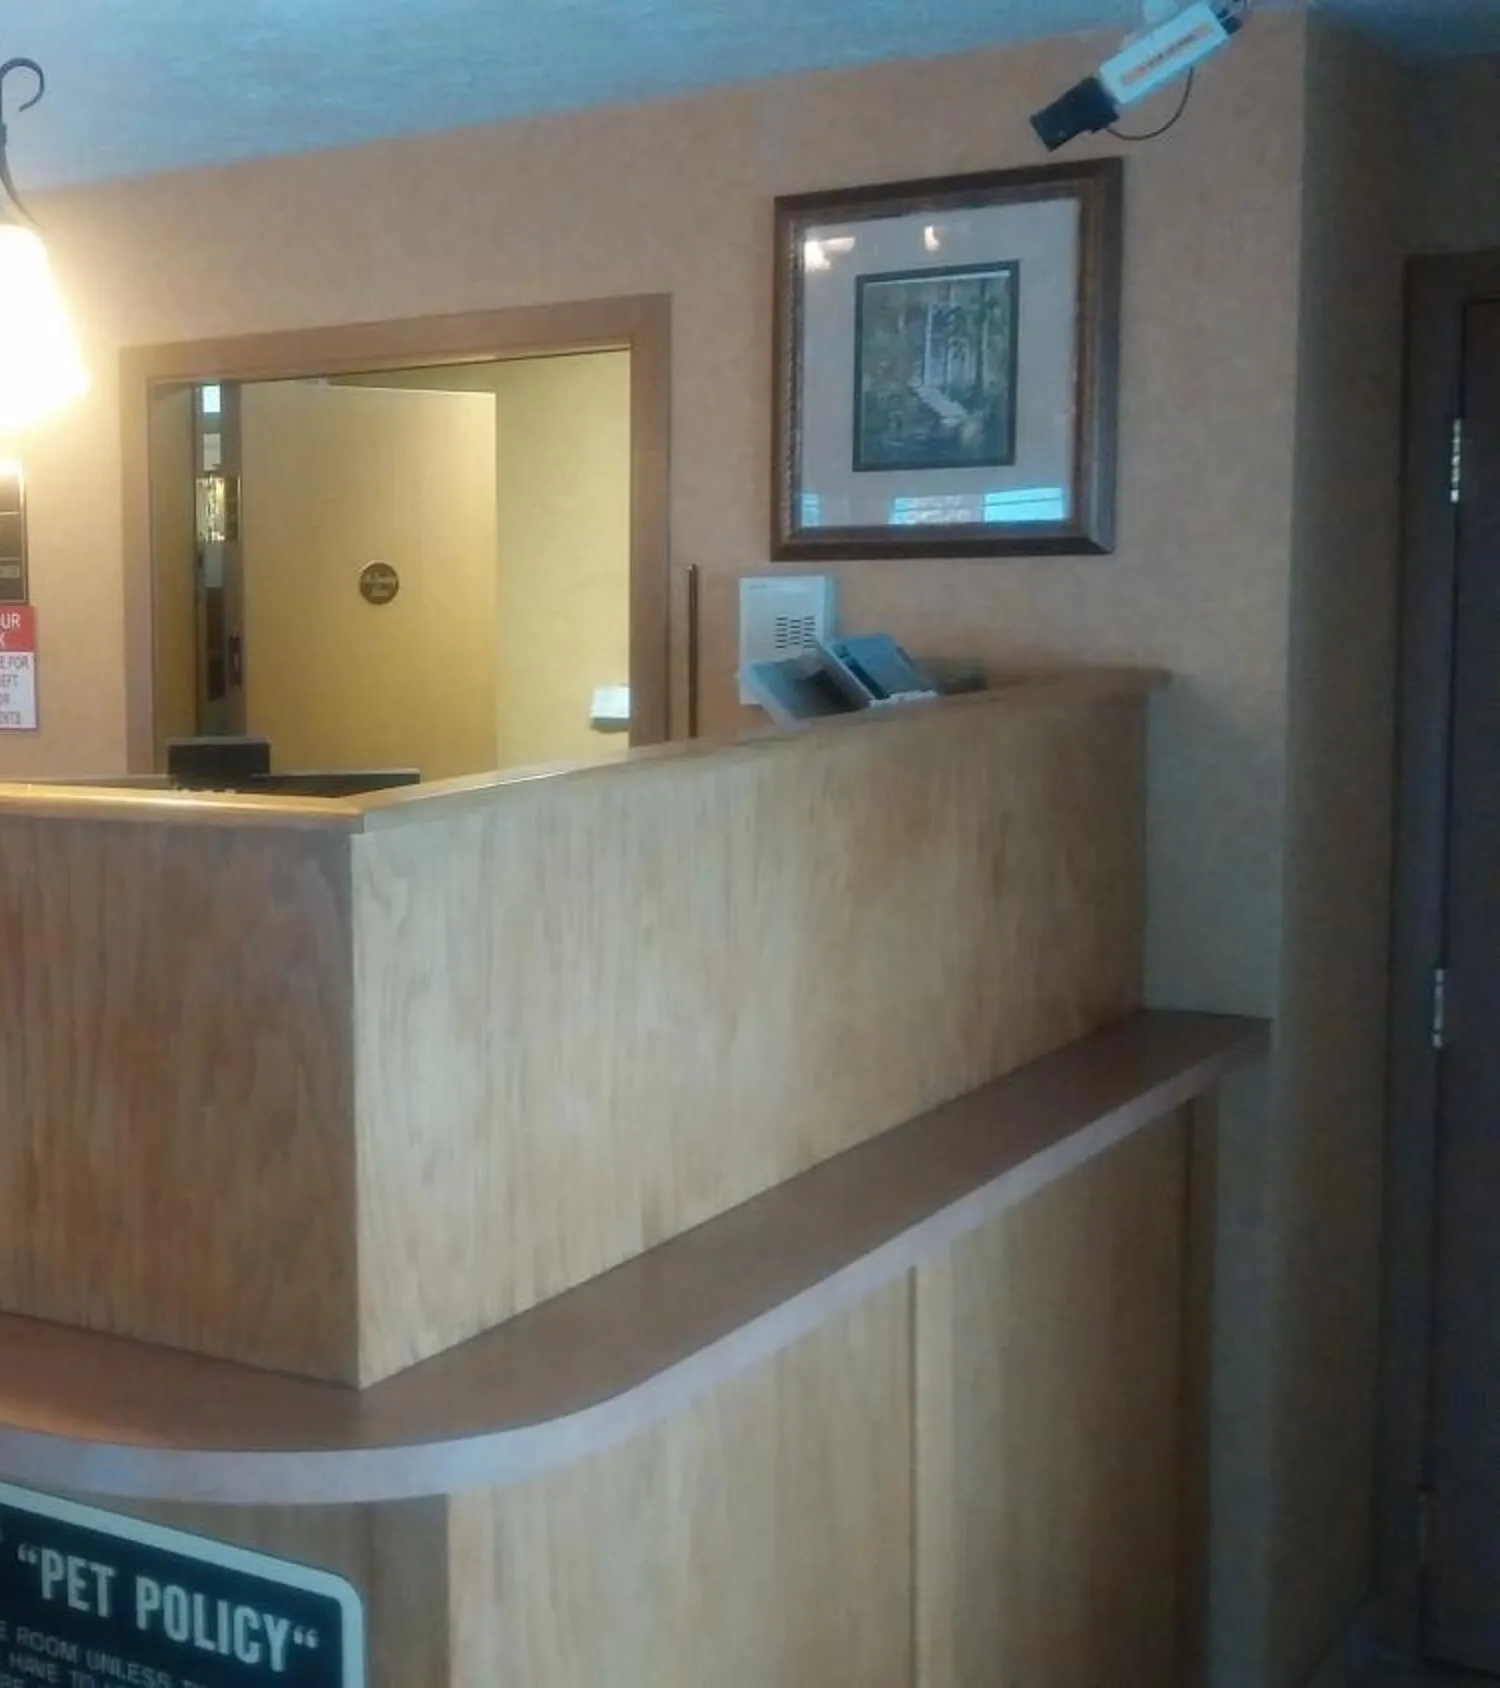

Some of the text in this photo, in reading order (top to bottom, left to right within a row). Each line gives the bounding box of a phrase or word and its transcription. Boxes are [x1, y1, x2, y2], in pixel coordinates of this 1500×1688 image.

[8, 655, 30, 669] FOR
[9, 1651, 60, 1685] HAVE
[16, 1626, 79, 1664] ROOM
[85, 1649, 174, 1688] UNLESS
